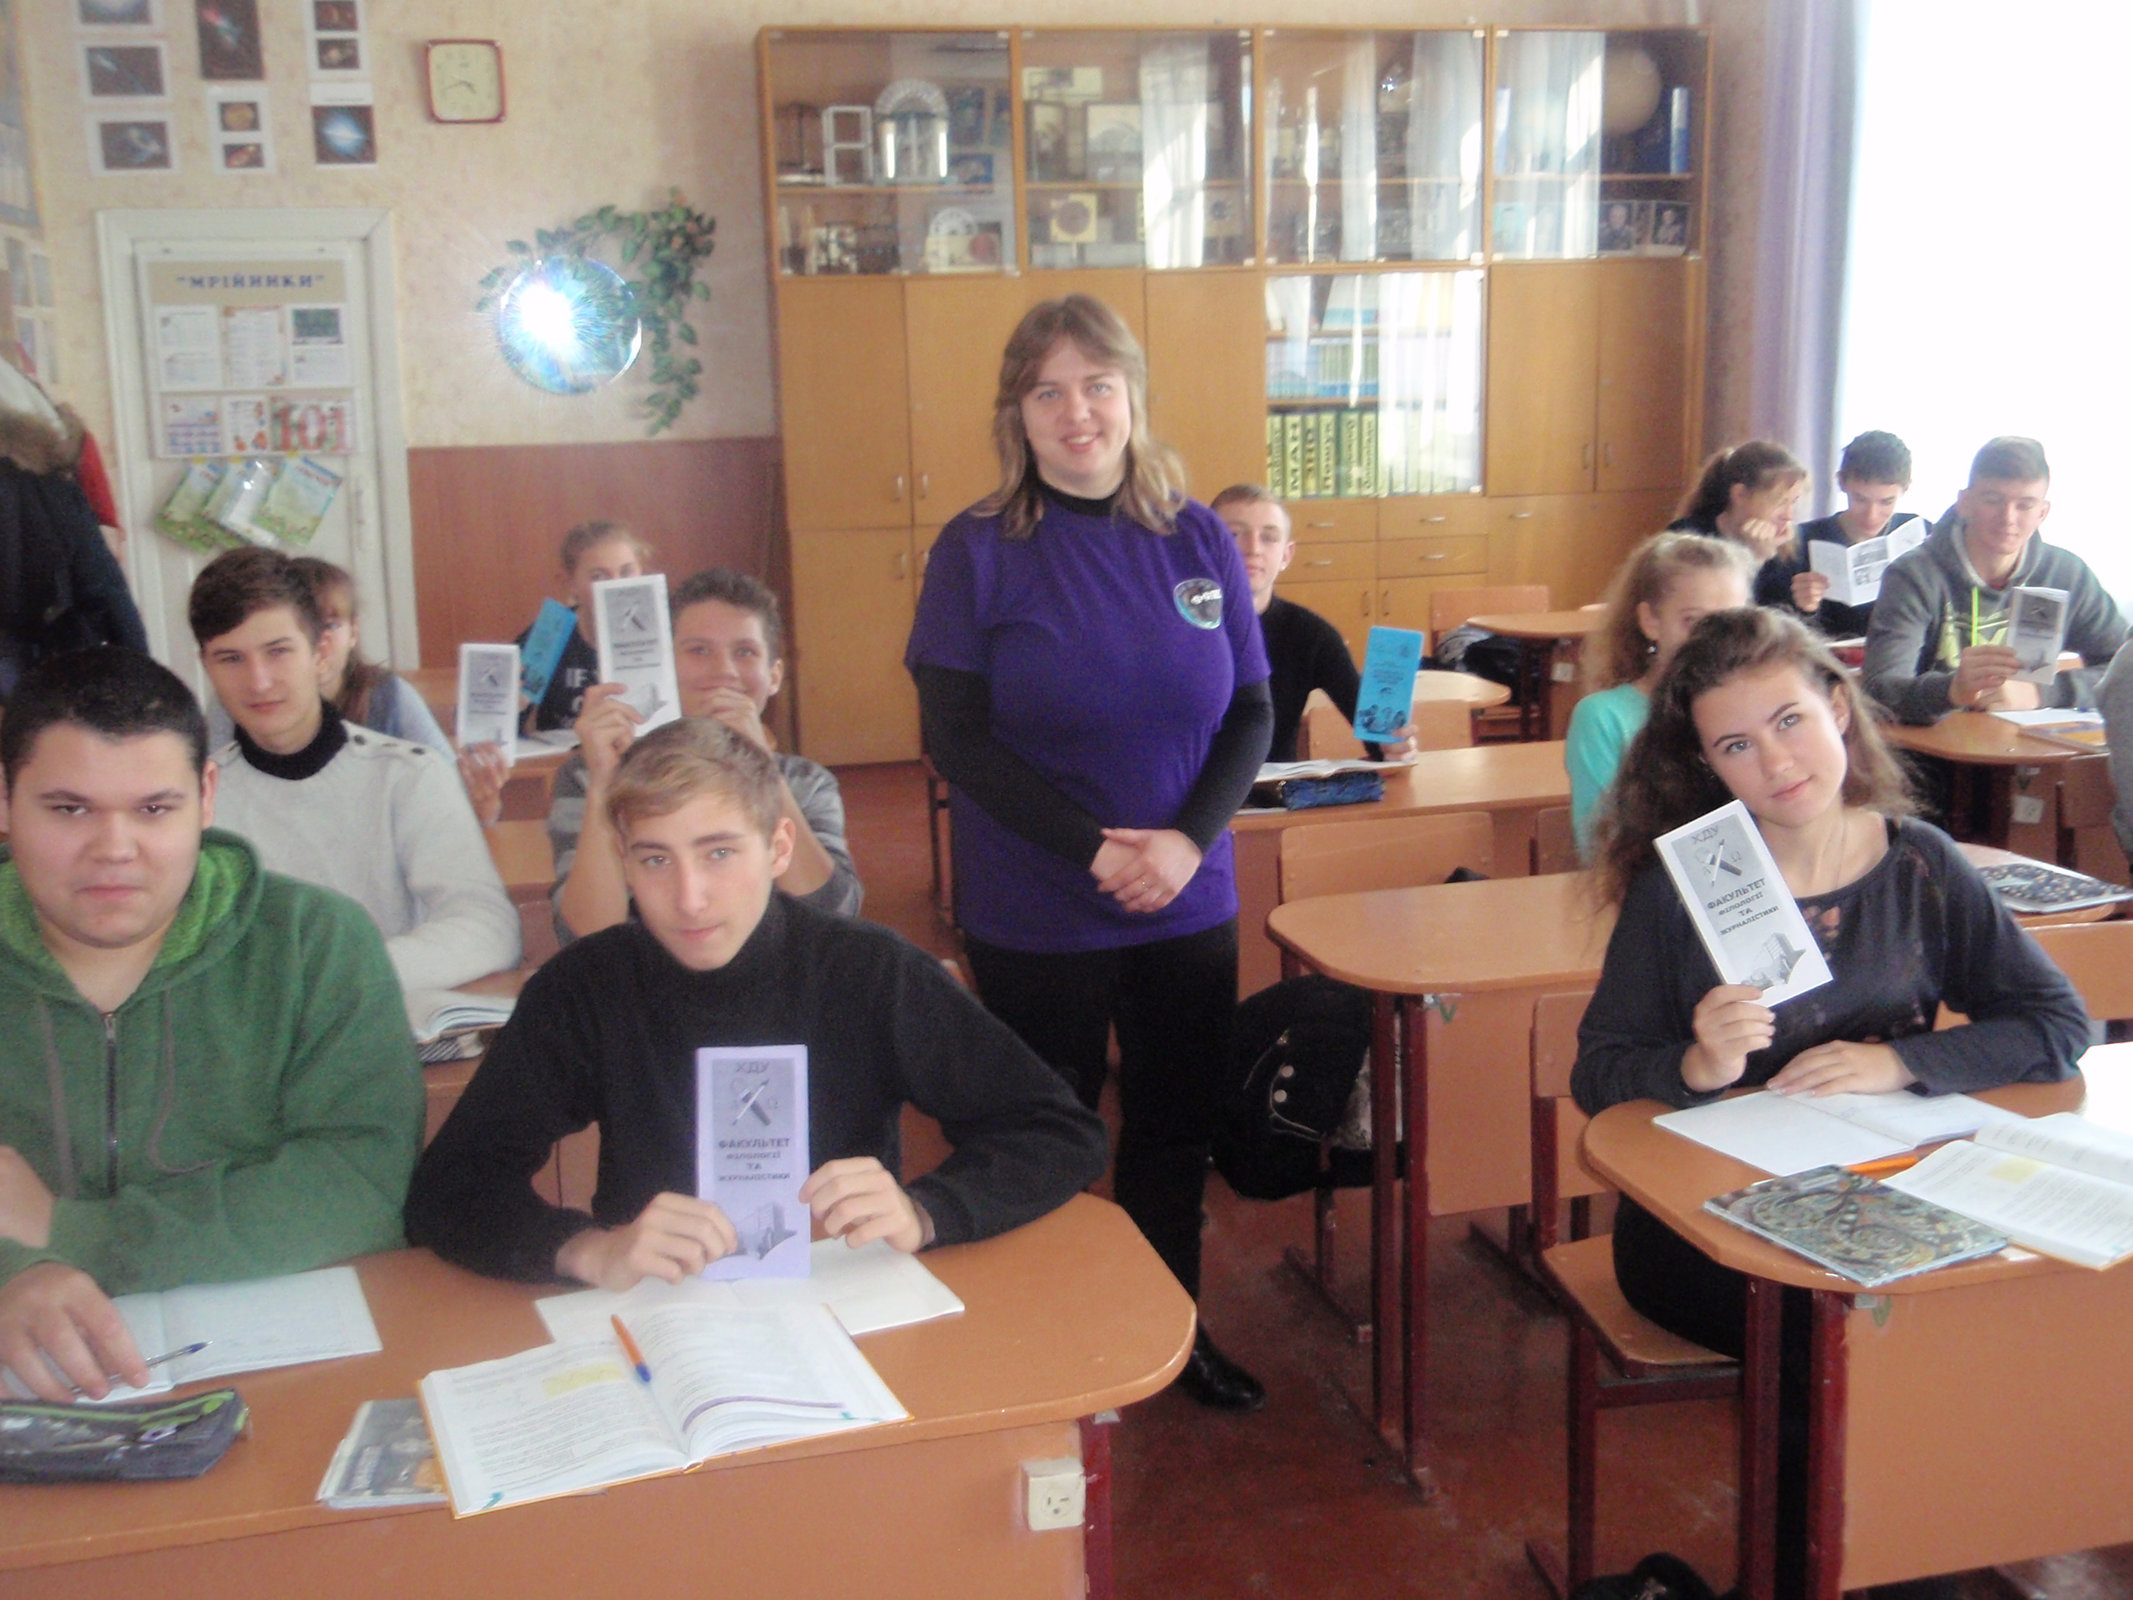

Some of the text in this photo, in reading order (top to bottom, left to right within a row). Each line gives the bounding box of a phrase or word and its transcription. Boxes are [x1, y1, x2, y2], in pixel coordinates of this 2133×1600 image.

[1691, 826, 1718, 844] ХДУ
[1708, 878, 1765, 909] ФАКУЛЬТЕТ
[1738, 908, 1753, 916] ТА
[1720, 906, 1779, 935] ЖУРНАЛІСТИКИ
[718, 1137, 790, 1149] ФАКУЛЬТЕТ
[746, 1162, 762, 1170] ТА
